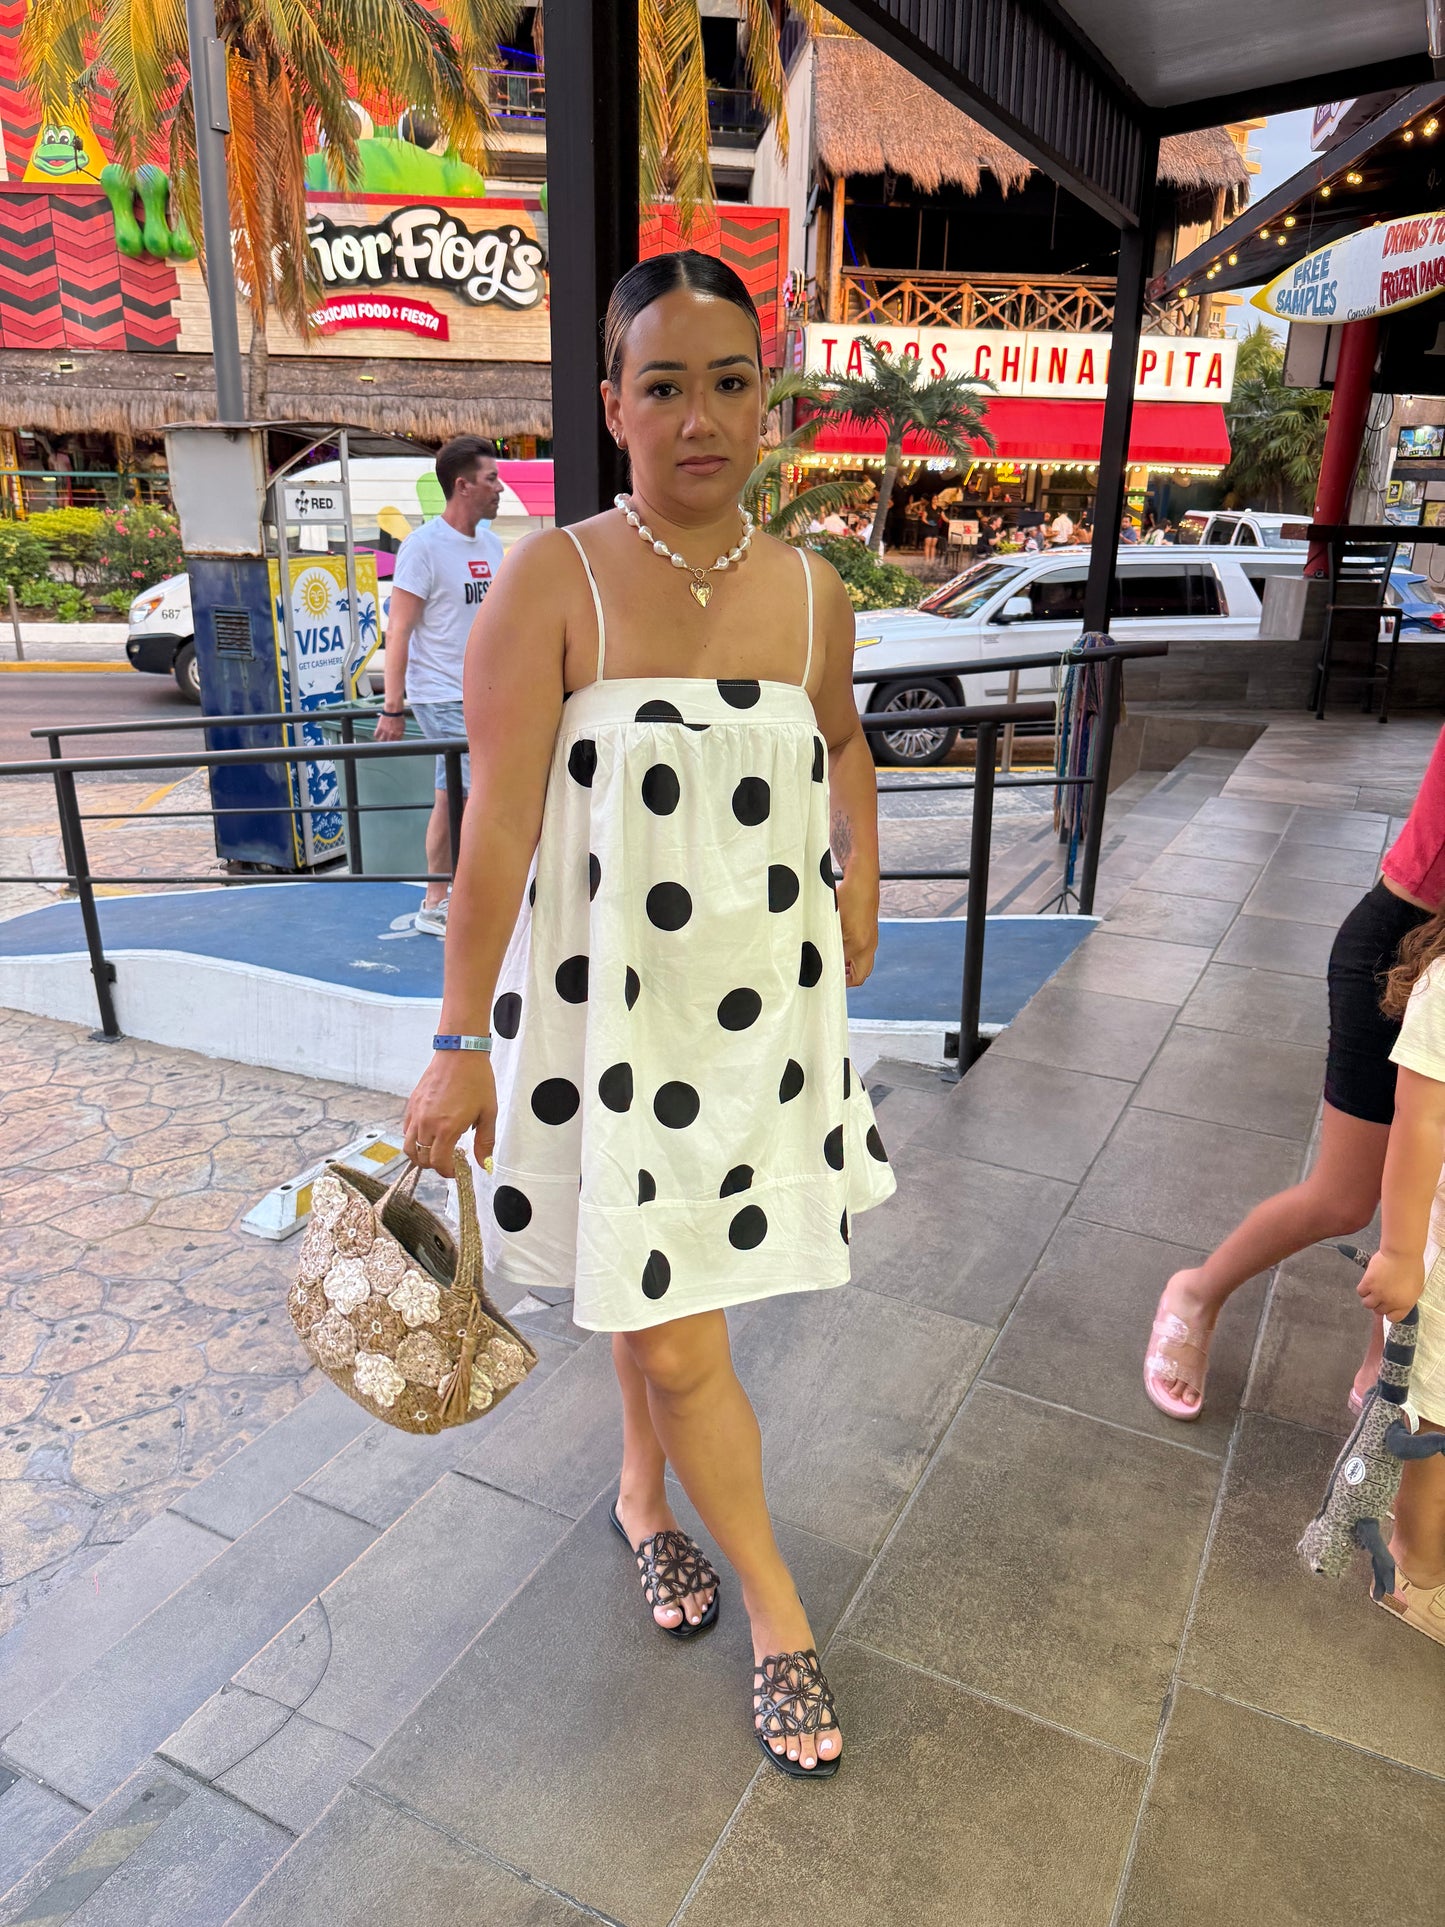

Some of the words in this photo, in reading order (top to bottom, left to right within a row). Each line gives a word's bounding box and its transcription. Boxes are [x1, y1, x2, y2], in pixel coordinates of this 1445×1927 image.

[1382, 217, 1432, 259] DRINKS
[391, 208, 542, 304] Frog's
[1293, 249, 1333, 289] FREE
[1275, 280, 1338, 317] SAMPLES
[1380, 265, 1418, 308] FROZEN
[358, 303, 391, 319] FOOD
[400, 306, 440, 332] FIESTA
[974, 344, 1223, 389] CHINAPITA
[311, 497, 334, 510] RED
[464, 580, 492, 605] DIES
[161, 608, 181, 620] 687
[294, 625, 345, 655] VISA
[299, 662, 311, 670] GET
[311, 659, 327, 669] CASH
[327, 657, 343, 666] HERE
